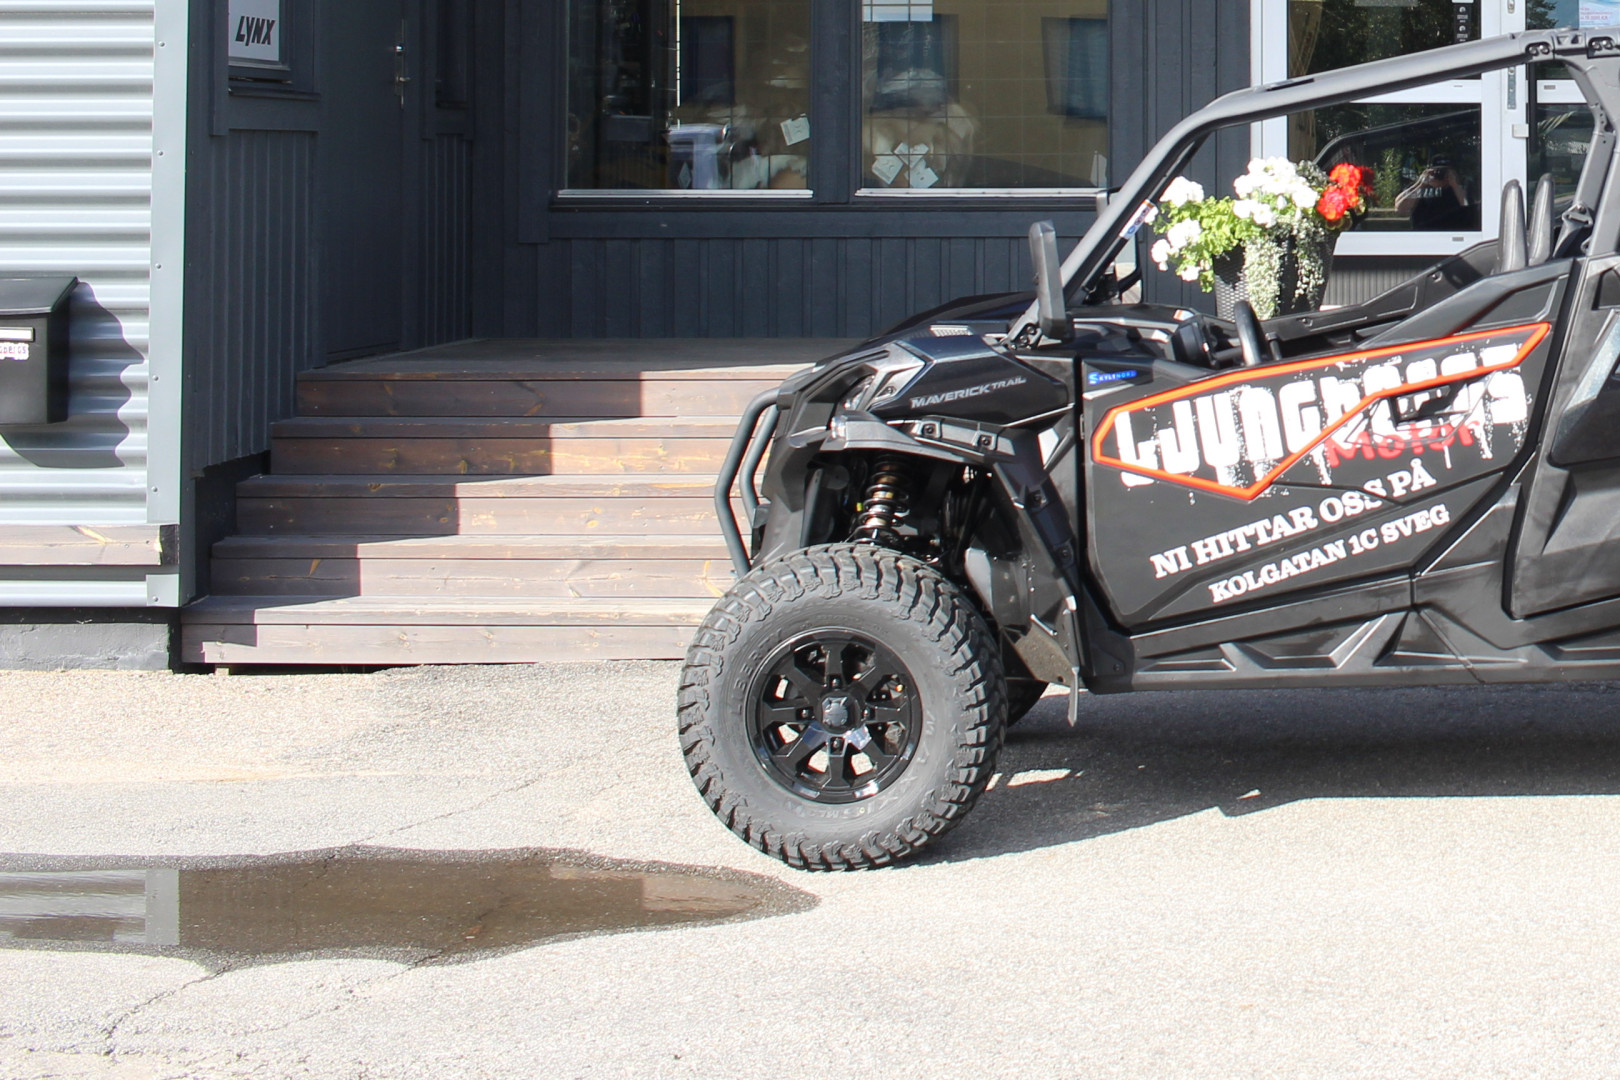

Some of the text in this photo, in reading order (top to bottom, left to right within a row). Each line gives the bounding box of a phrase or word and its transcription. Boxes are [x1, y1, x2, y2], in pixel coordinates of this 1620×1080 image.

[235, 16, 276, 47] LYNX
[910, 376, 1027, 409] MAVERICK TRAIL
[1149, 457, 1437, 579] NI HITTAR OSS PÅ
[1208, 503, 1451, 604] KOLGATAN 1C SVEG
